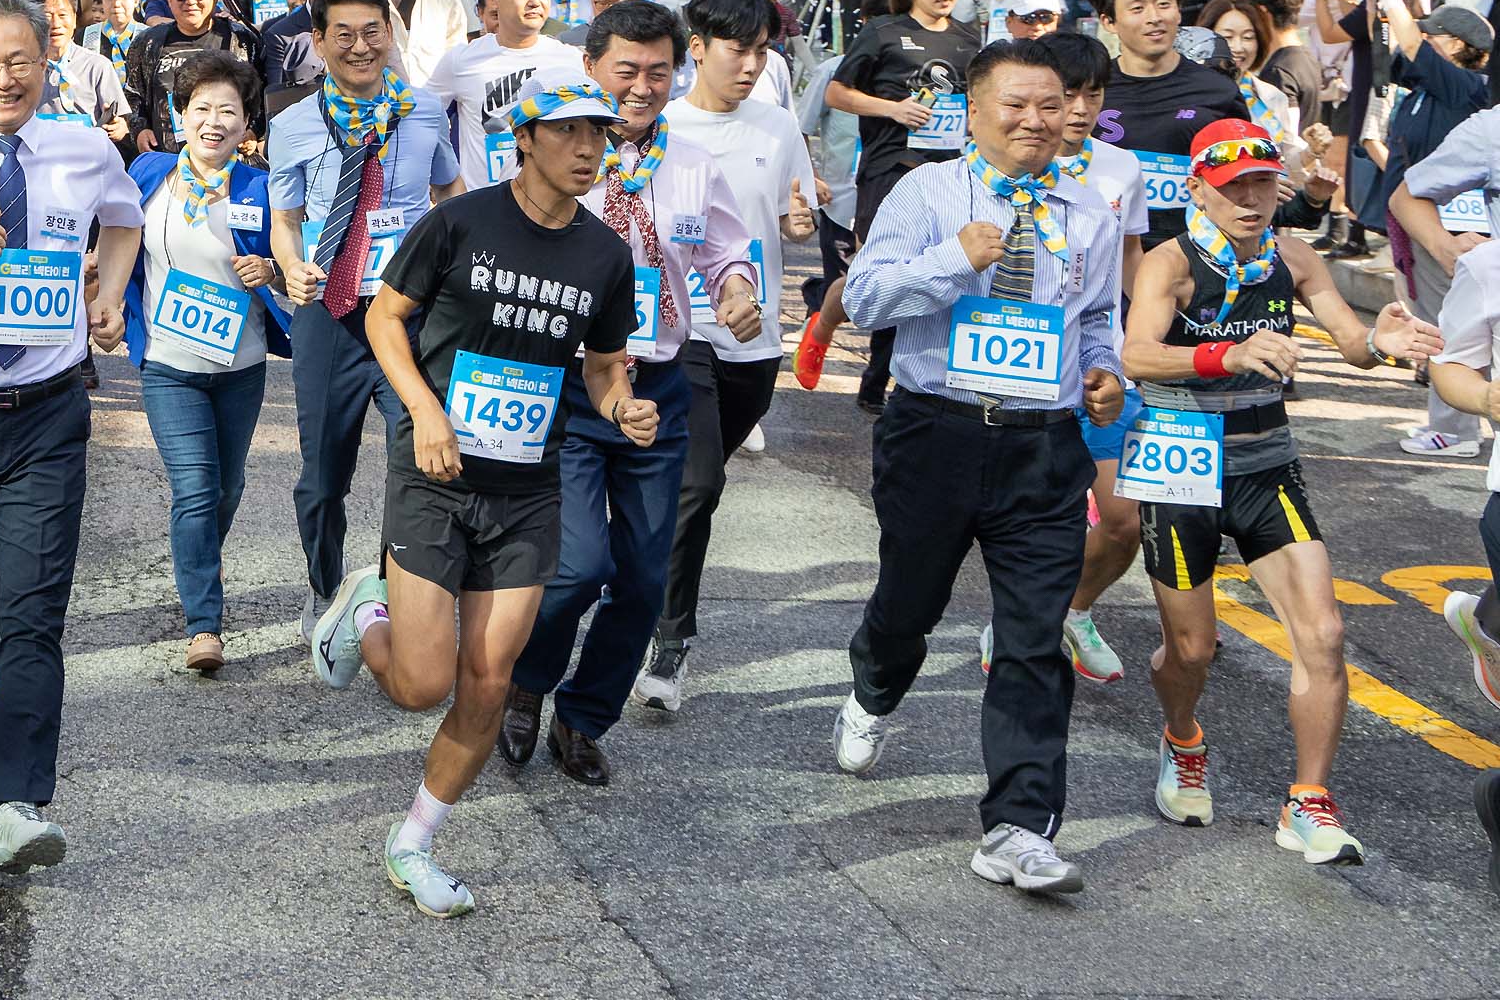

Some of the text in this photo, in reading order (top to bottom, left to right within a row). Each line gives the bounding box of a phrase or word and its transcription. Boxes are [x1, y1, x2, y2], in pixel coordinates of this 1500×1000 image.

[919, 115, 963, 131] 727
[45, 215, 77, 231] 장인홍
[675, 222, 702, 236] 김철수
[33, 265, 61, 277] 넥타이
[62, 266, 70, 277] 런
[470, 265, 593, 317] RUNNER
[171, 299, 232, 341] 1014
[492, 302, 569, 339] KING
[1038, 318, 1049, 331] 런
[968, 332, 1045, 370] 1021
[506, 377, 538, 391] 넥타이
[538, 382, 549, 393] 런
[463, 391, 546, 434] 1439
[474, 434, 504, 450] A-34
[1126, 438, 1213, 476] 2803
[1166, 487, 1194, 497] A-11
